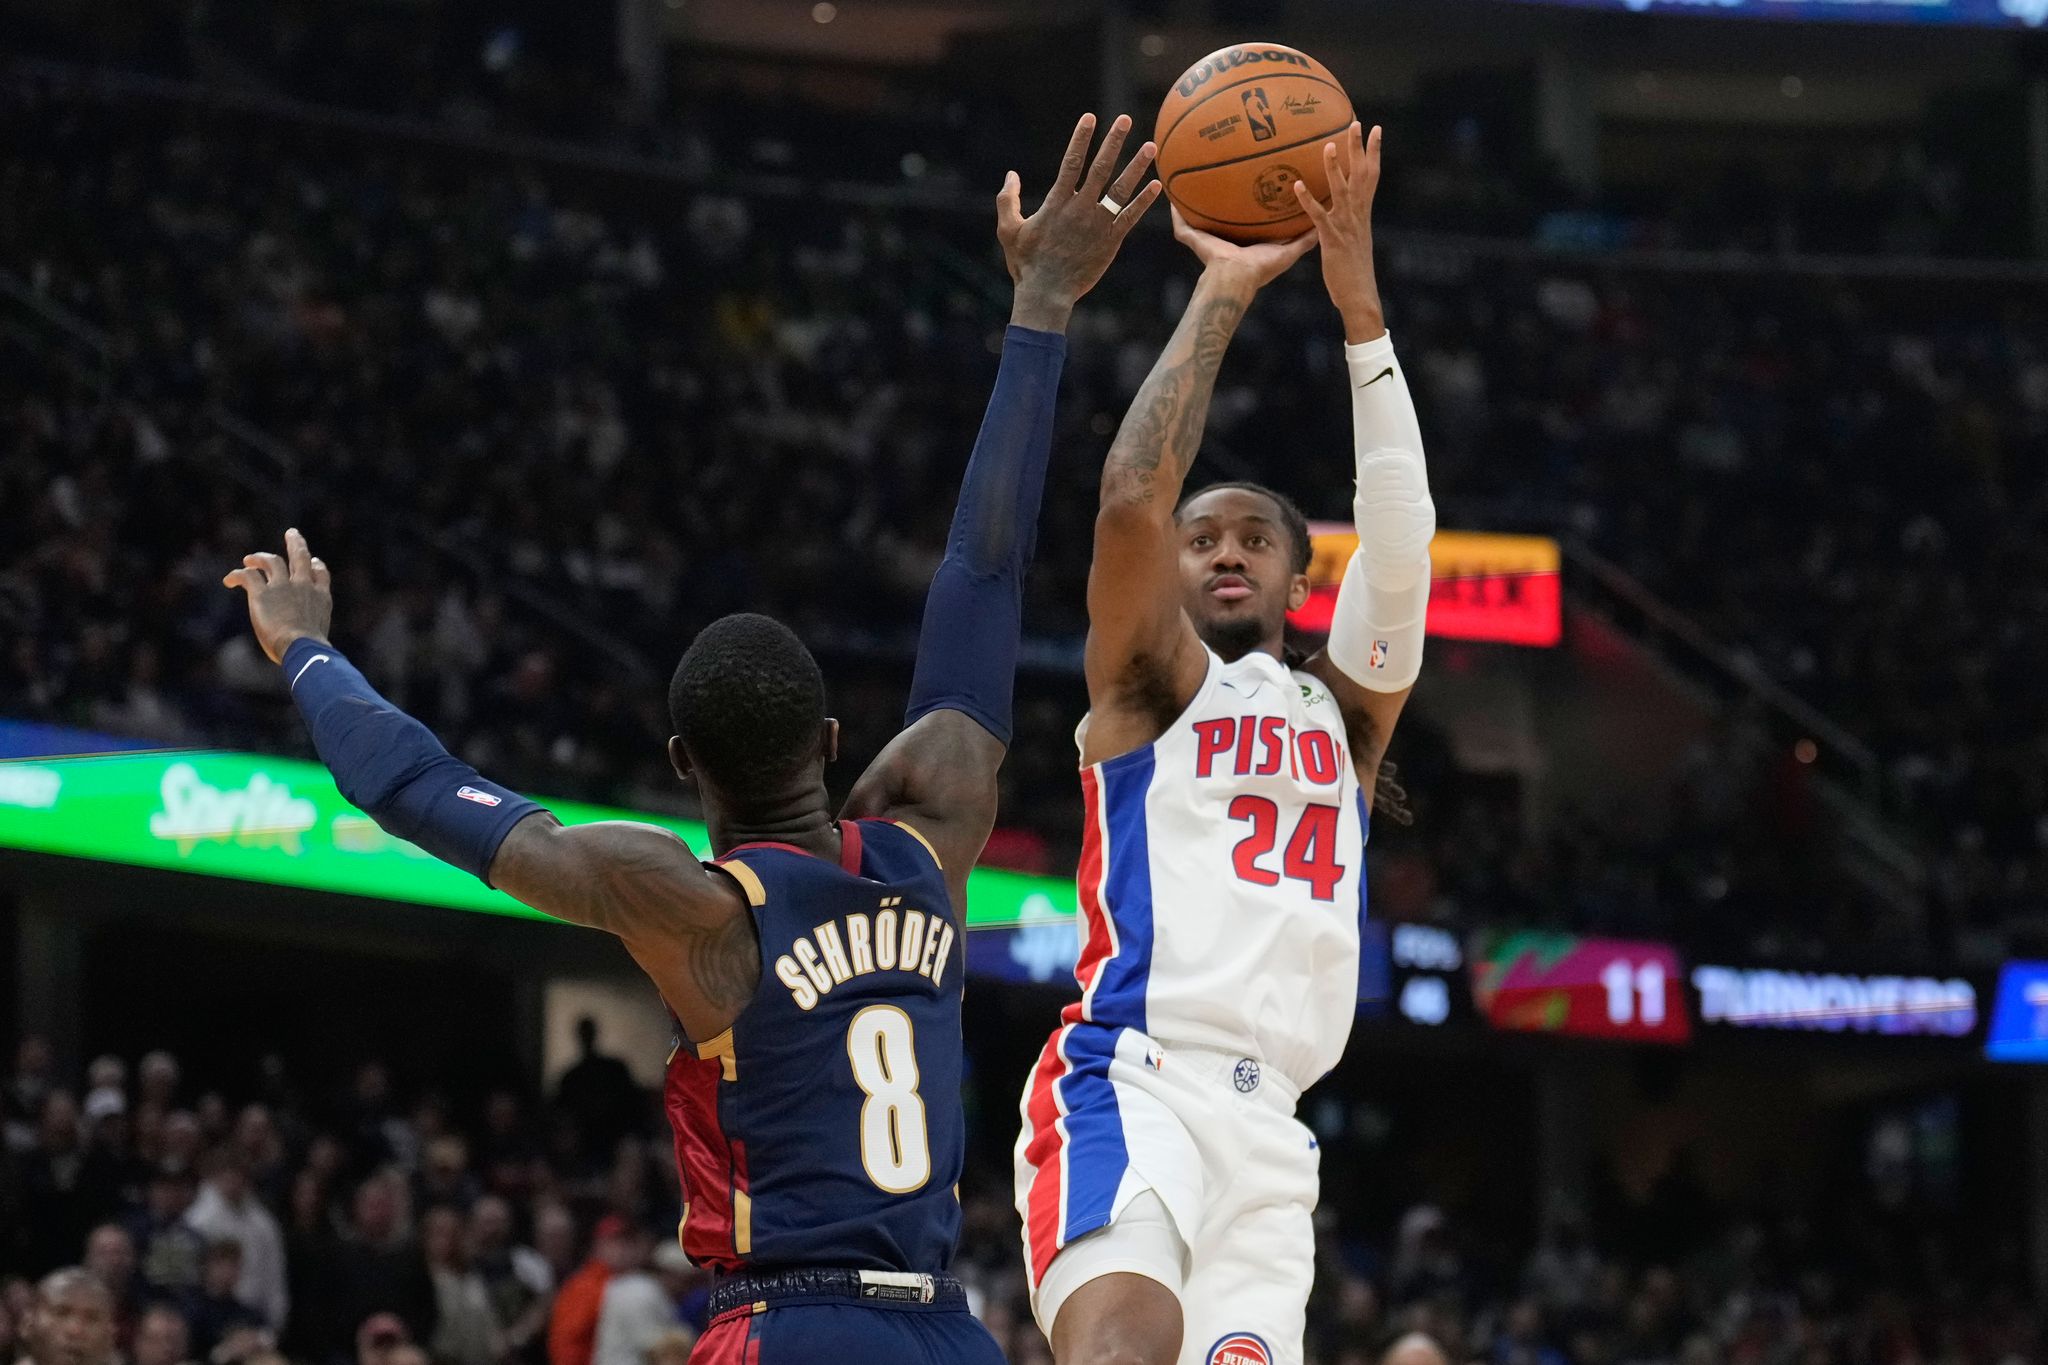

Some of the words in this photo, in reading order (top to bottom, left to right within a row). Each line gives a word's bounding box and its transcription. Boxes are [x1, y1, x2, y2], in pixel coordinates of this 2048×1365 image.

[1192, 715, 1346, 788] PISO
[1228, 794, 1346, 902] 24
[774, 896, 955, 1011] SCHRÖDER
[1603, 958, 1666, 1026] 11
[846, 1004, 931, 1194] 8
